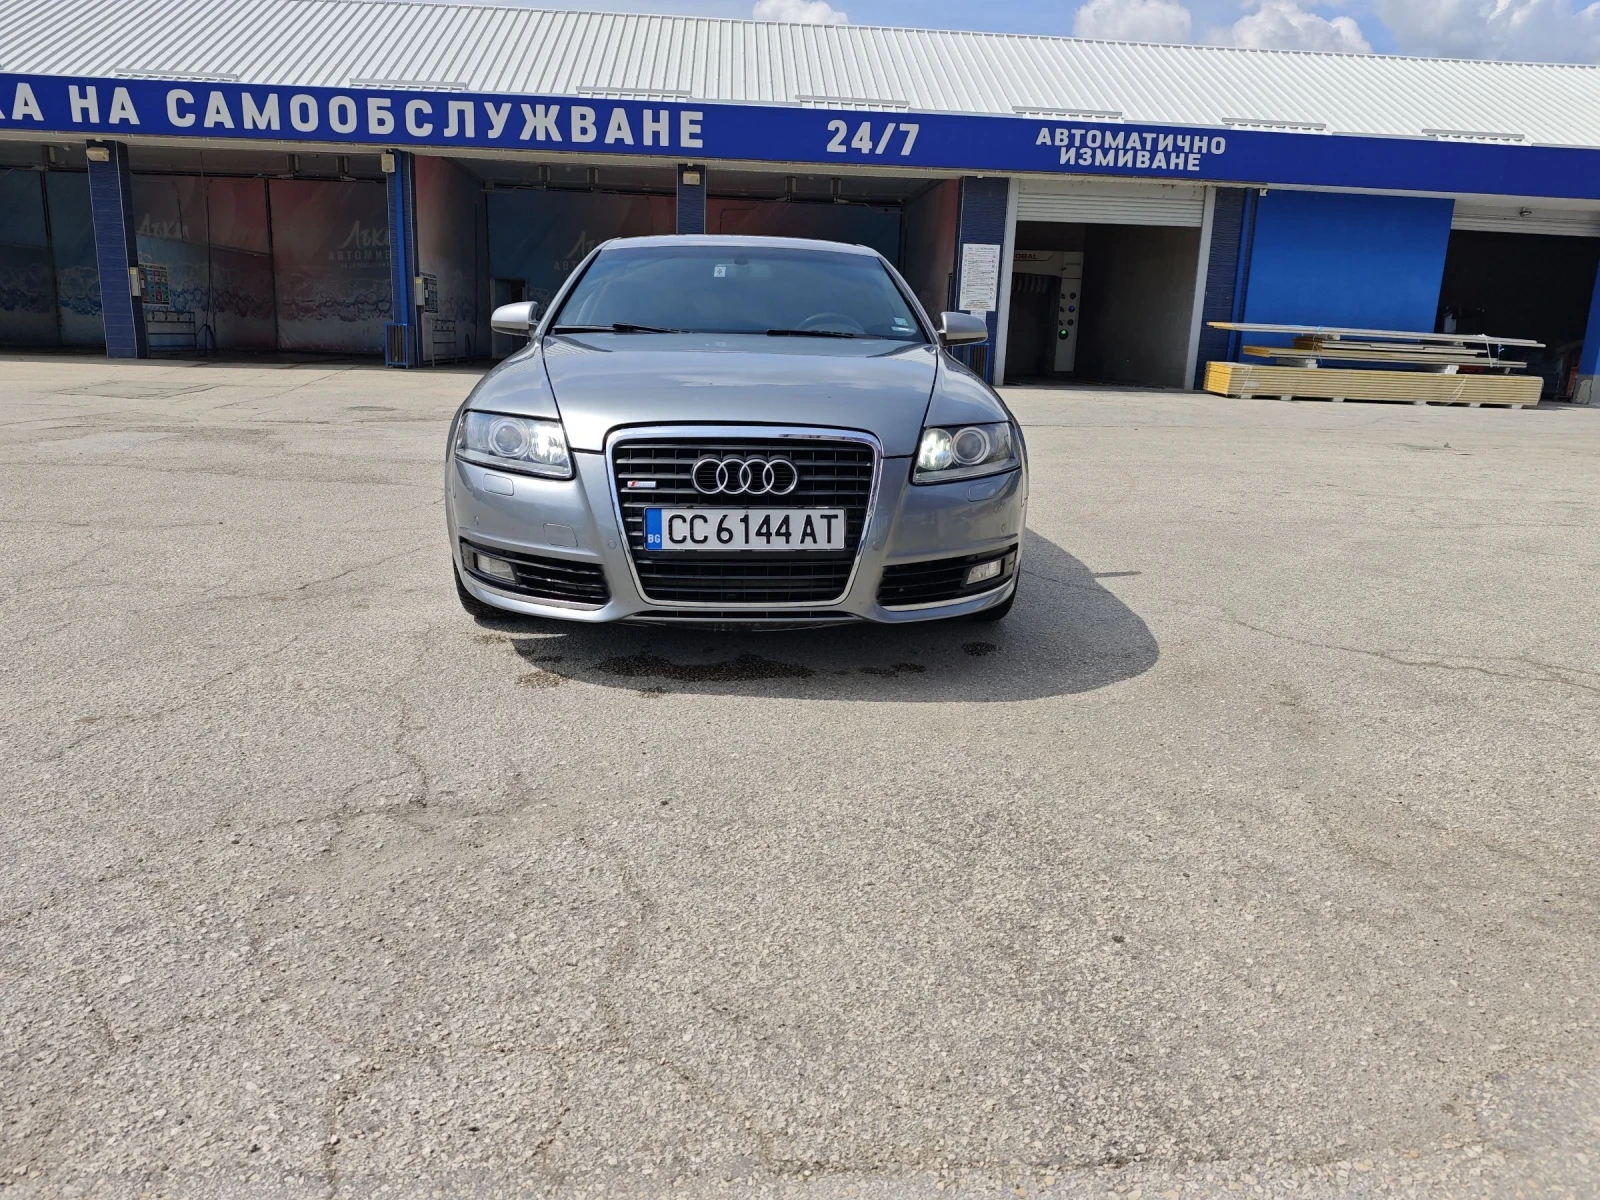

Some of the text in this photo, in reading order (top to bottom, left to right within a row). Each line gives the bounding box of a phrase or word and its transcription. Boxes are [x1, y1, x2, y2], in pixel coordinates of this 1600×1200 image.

[0, 82, 704, 149] А НА САМООБСЛУЖВАНЕ
[826, 119, 920, 156] 24/7
[1035, 127, 1226, 155] АВТОМАТИЧНО
[1059, 146, 1201, 171] ИЗМИВАНЕ
[647, 534, 661, 543] BG
[716, 514, 792, 545] 6144
[799, 514, 839, 545] AT
